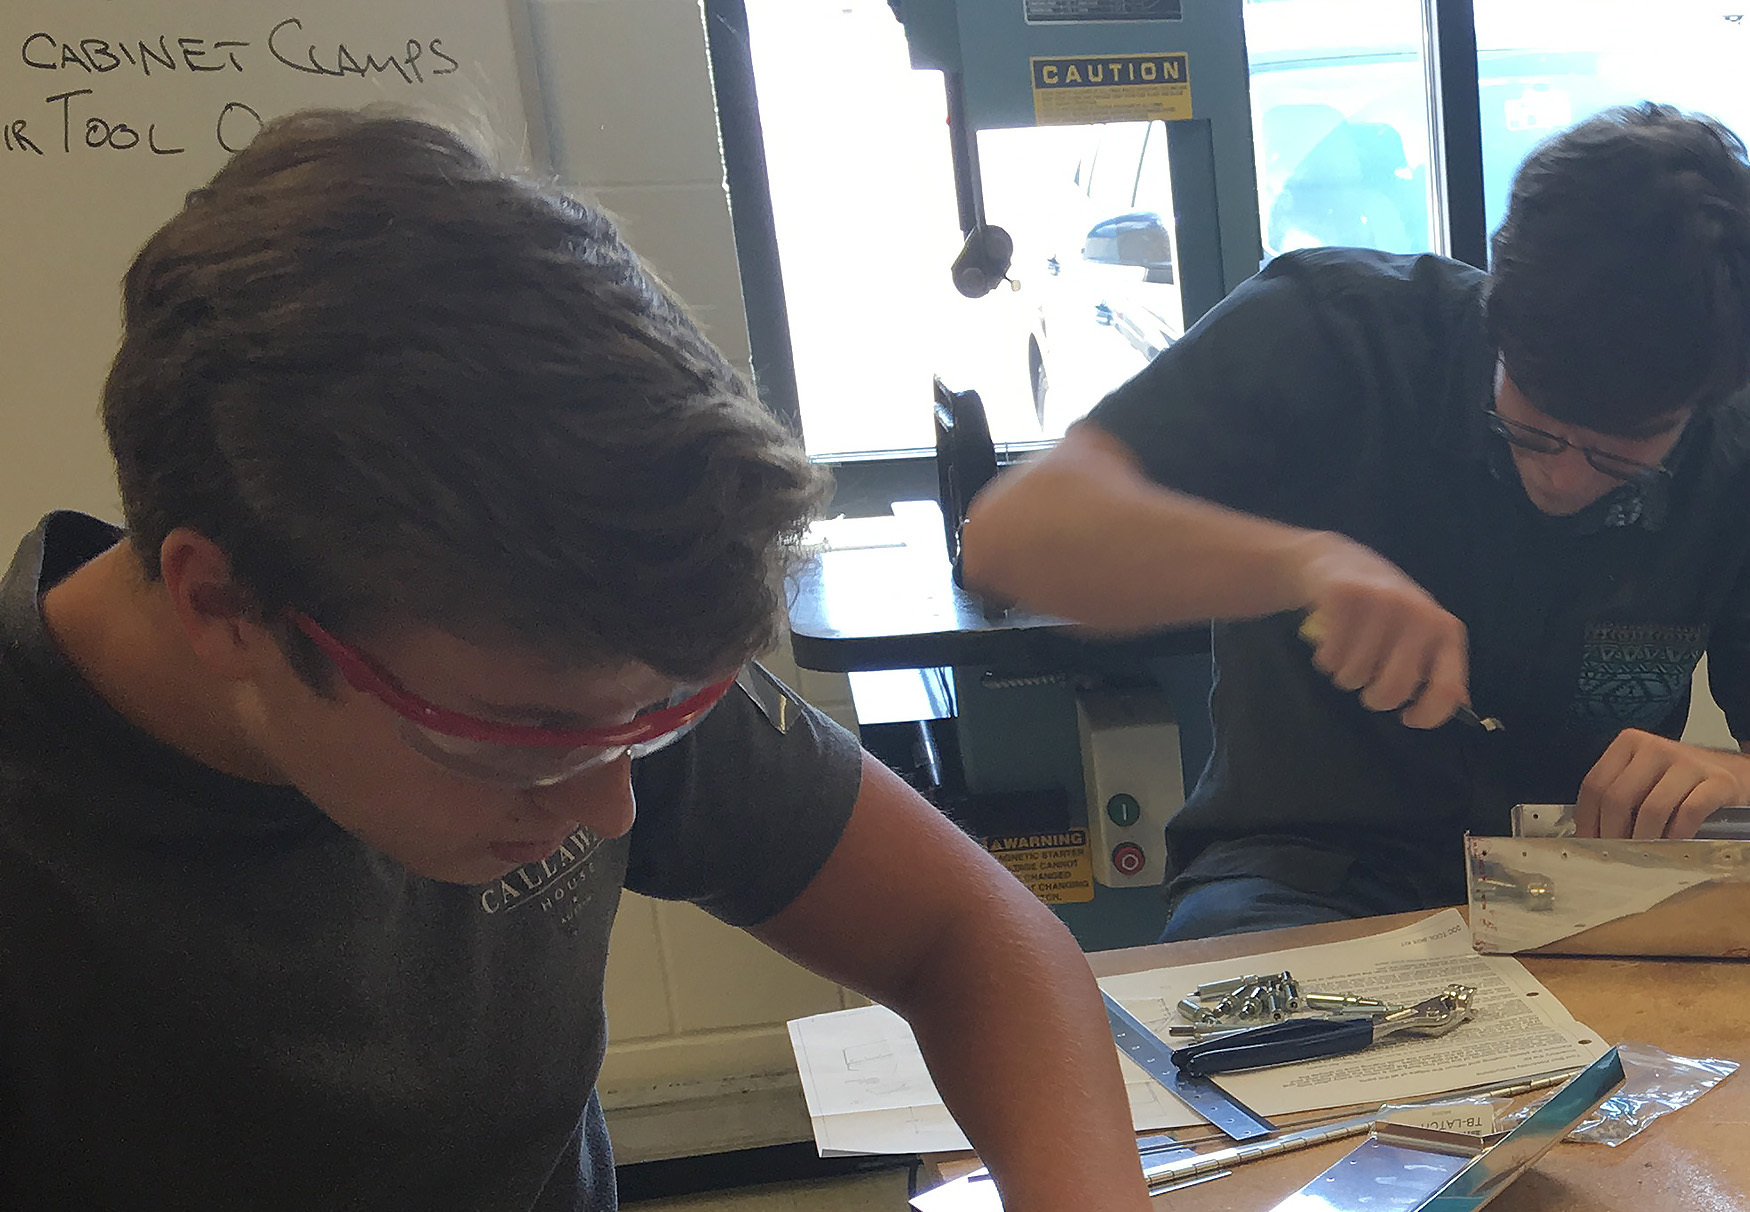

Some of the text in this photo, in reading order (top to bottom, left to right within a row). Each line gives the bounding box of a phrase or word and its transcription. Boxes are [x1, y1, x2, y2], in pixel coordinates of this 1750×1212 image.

[22, 18, 459, 84] CABINET CLAMPS
[1042, 62, 1179, 84] CAUTION
[2, 89, 263, 154] IR TOOL O
[1003, 833, 1082, 848] WARNING
[541, 862, 596, 912] HOUSE
